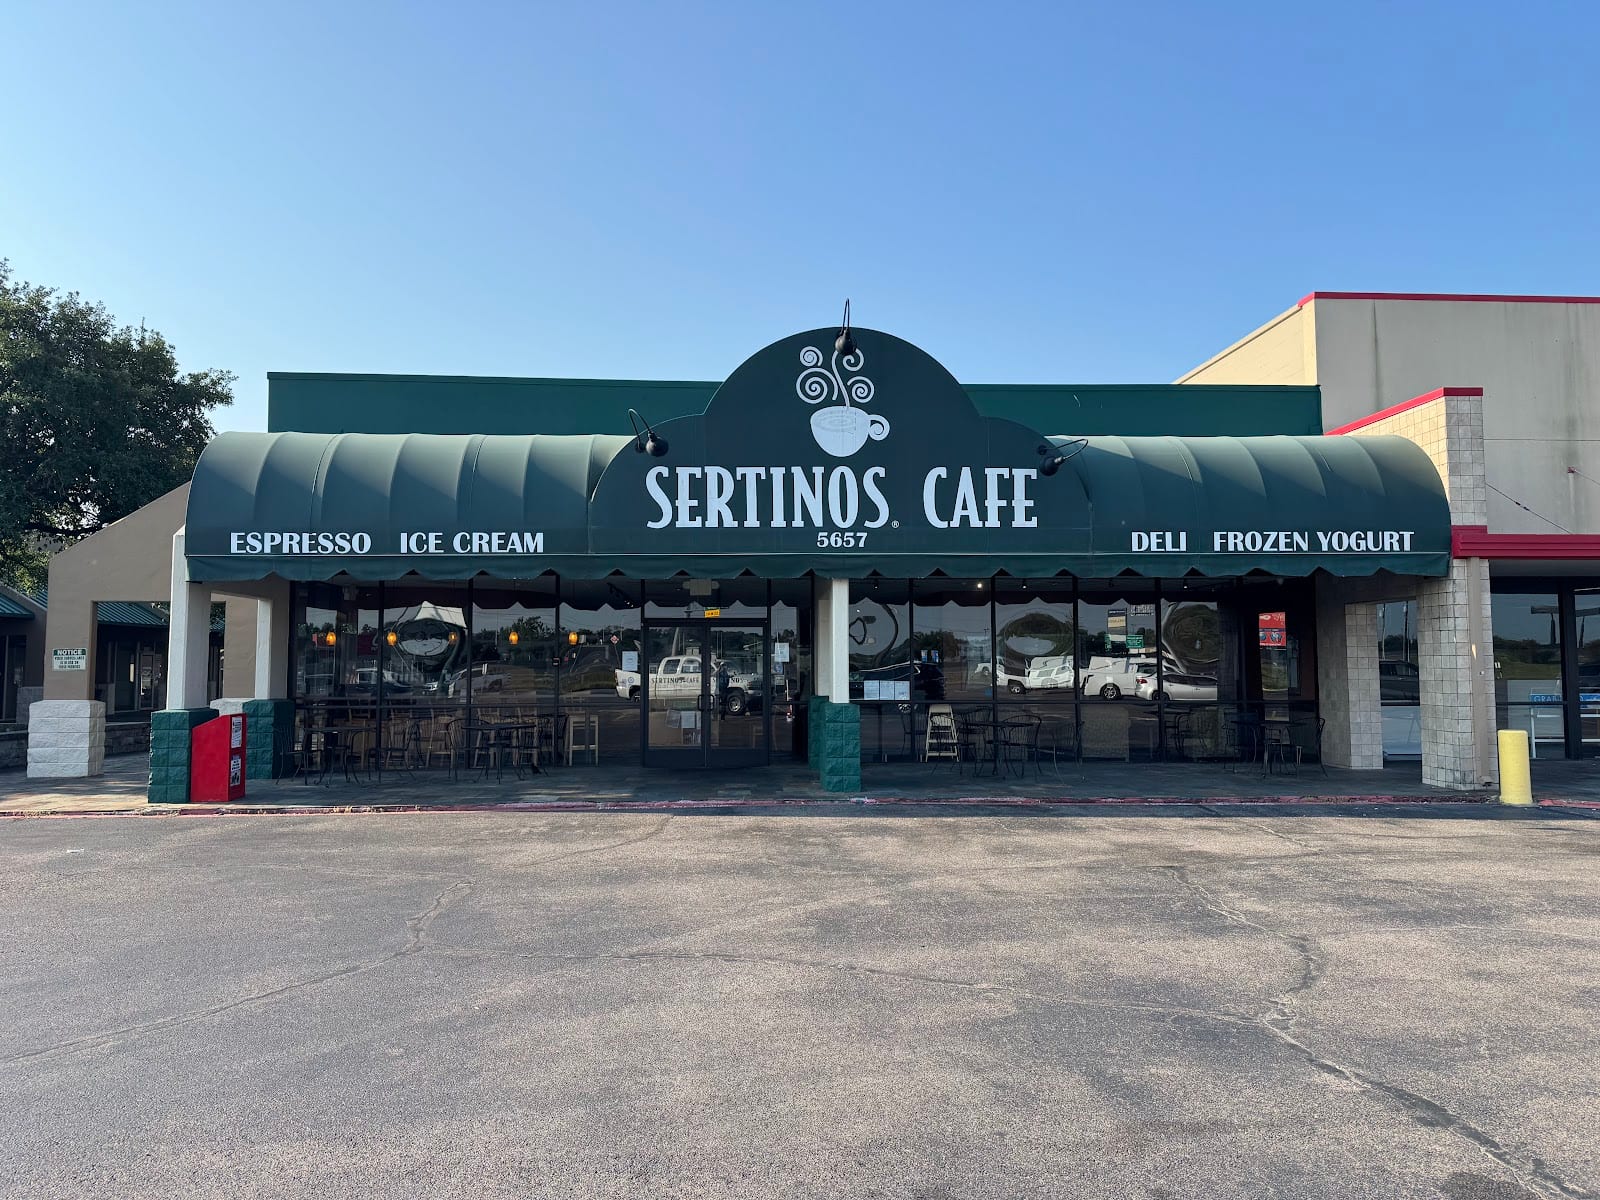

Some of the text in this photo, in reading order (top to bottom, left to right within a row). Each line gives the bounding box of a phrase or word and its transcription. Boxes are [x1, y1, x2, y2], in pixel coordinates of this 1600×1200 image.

[923, 466, 1038, 528] CAFE
[230, 532, 372, 554] ESPRESSO
[400, 532, 544, 553] ICE CREAM
[816, 531, 868, 548] 5657
[1131, 531, 1187, 552] DELI
[1213, 531, 1415, 552] FROZEN YOGURT
